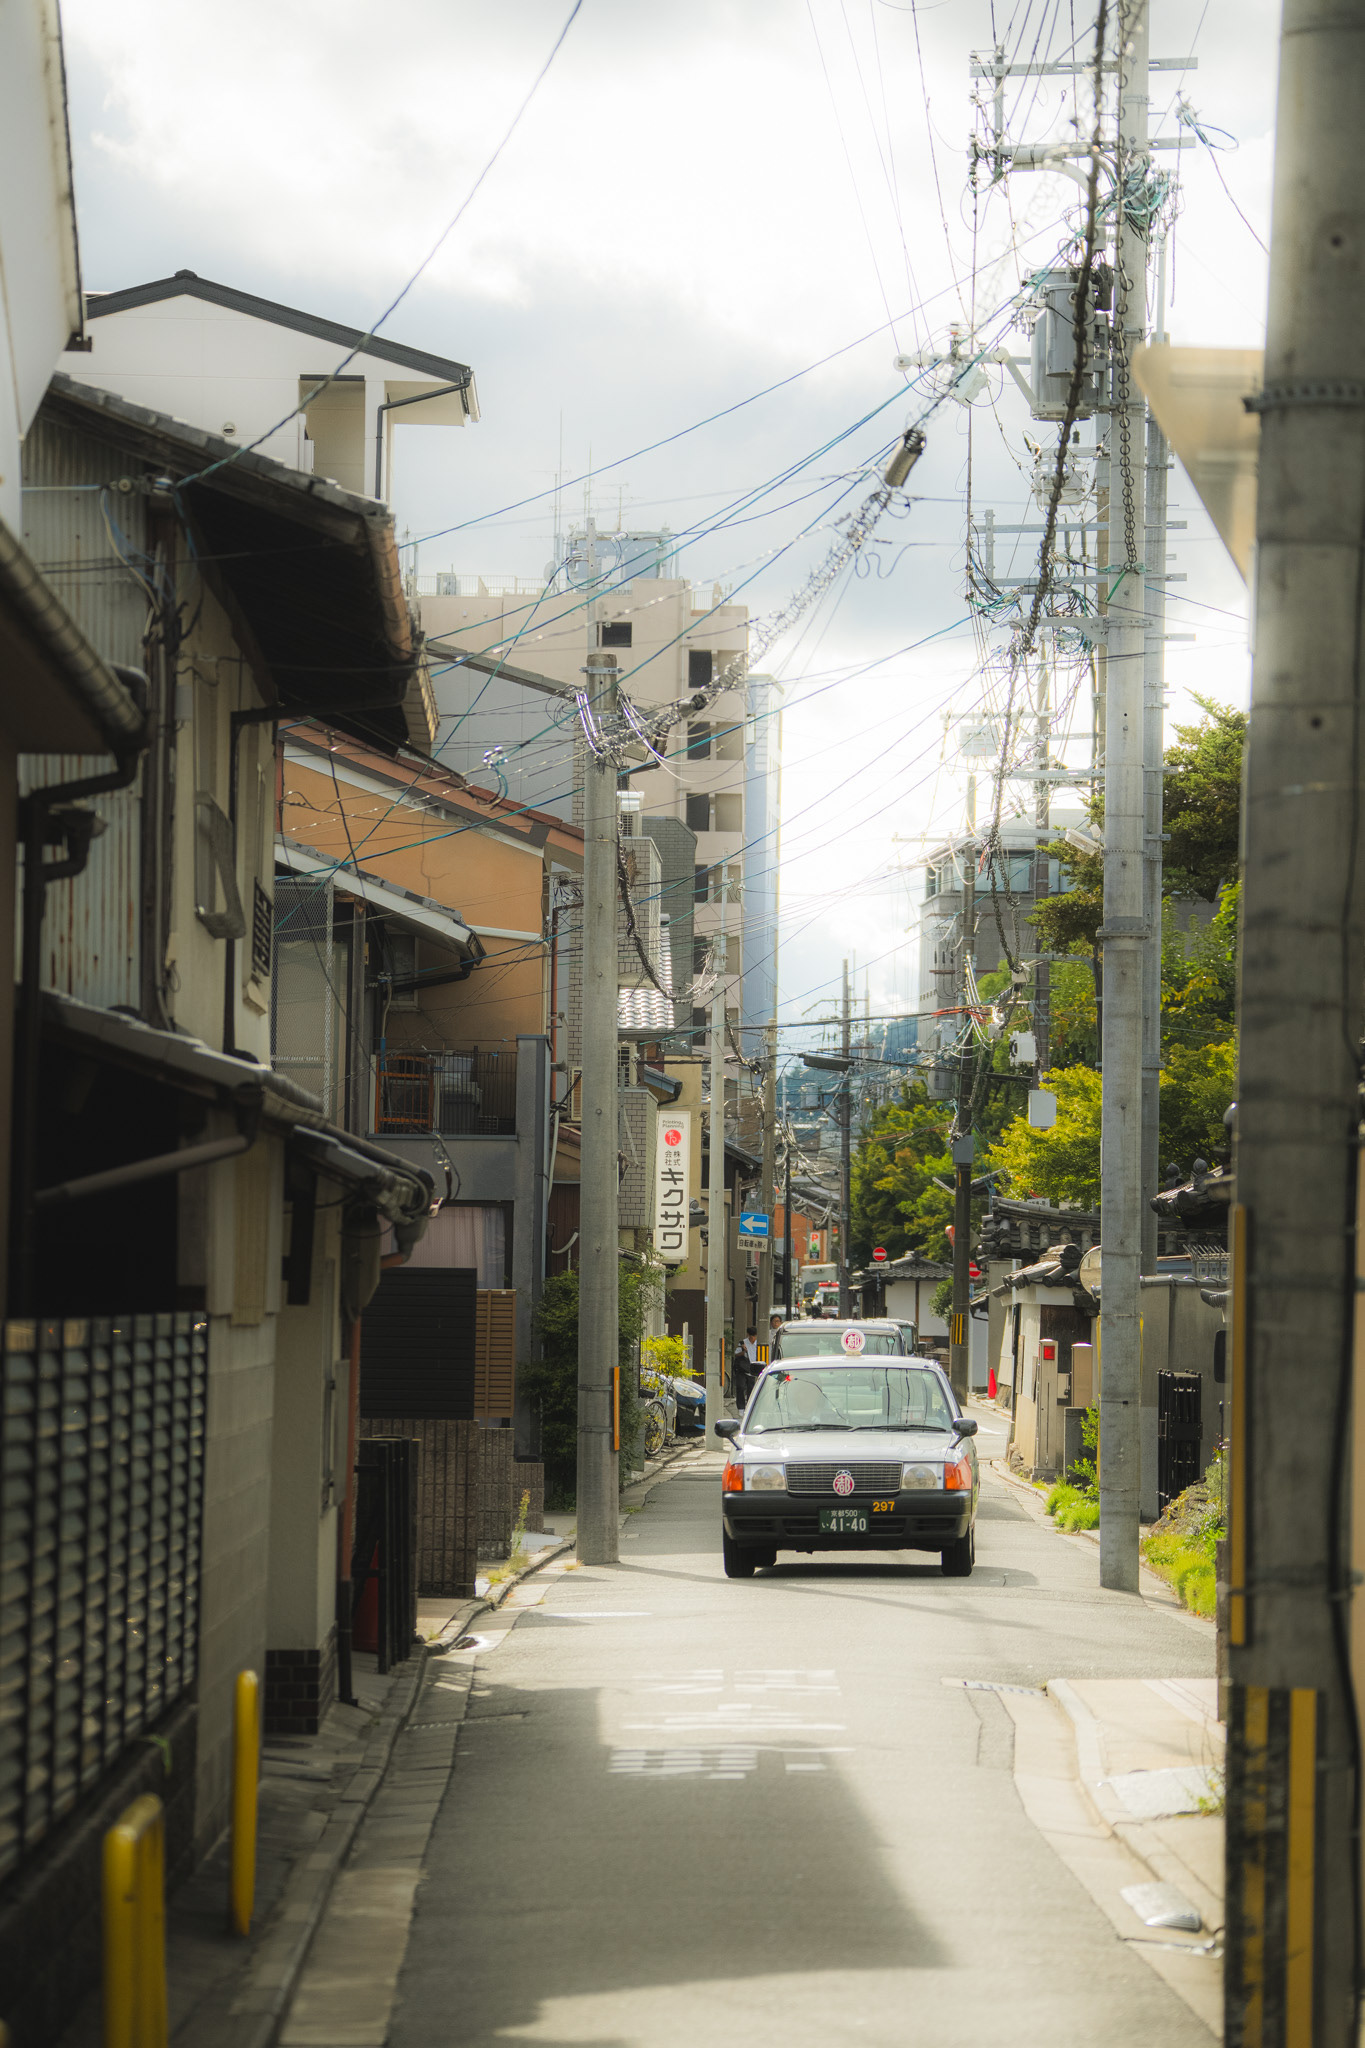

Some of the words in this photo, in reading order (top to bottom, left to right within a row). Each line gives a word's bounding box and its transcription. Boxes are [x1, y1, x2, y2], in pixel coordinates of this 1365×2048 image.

[659, 1167, 685, 1250] キクザワ
[739, 1238, 766, 1249] 自転車を除く
[811, 1234, 819, 1242] P
[835, 1478, 852, 1493] 都
[872, 1501, 895, 1512] 297
